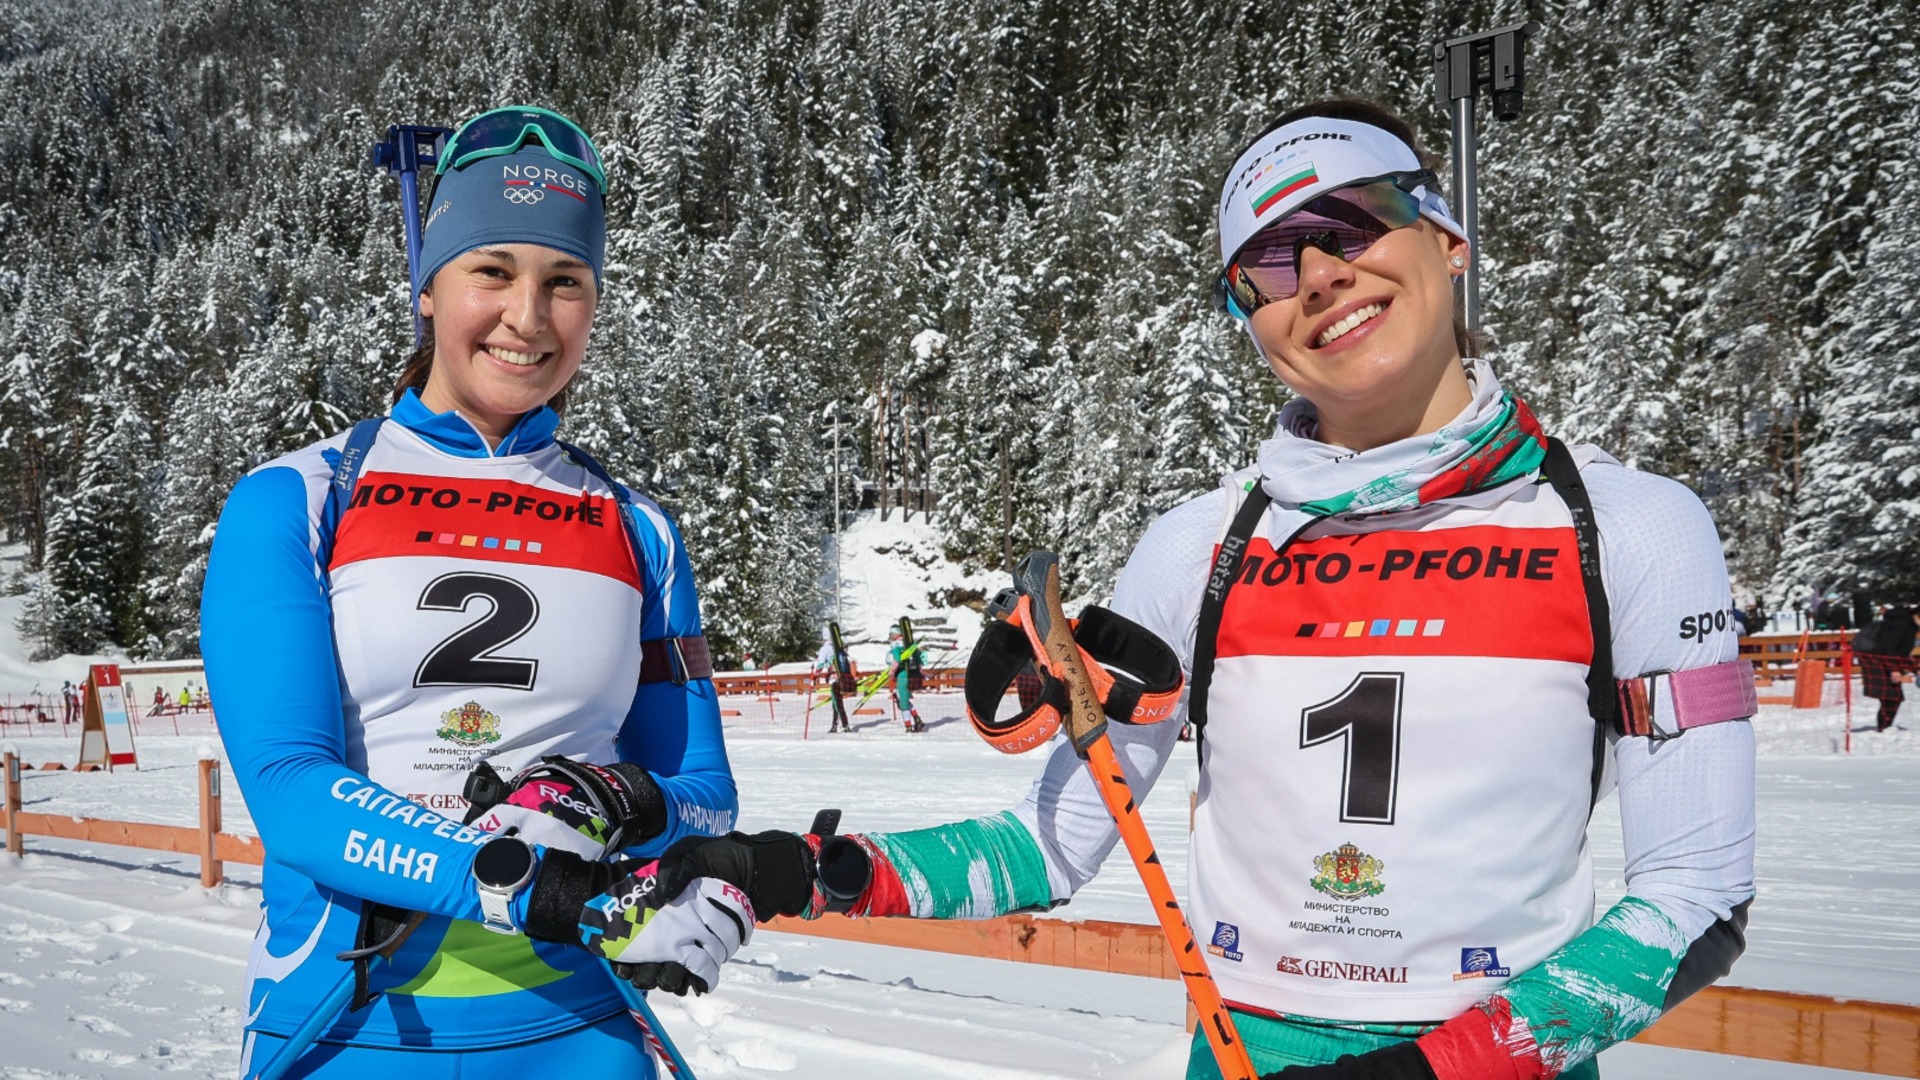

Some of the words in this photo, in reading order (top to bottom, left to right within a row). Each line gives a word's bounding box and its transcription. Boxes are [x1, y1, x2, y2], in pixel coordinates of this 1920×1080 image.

[503, 164, 587, 197] NORGE
[412, 570, 541, 692] 2
[103, 672, 111, 685] 1
[1299, 671, 1405, 826] 1
[343, 829, 439, 884] БАНЯ
[1304, 900, 1390, 917] МИНИСТЕРСТВО
[1335, 915, 1351, 924] НА
[1288, 920, 1345, 935] МЛАДЕЖТА
[1347, 926, 1356, 936] И
[1357, 927, 1403, 940] СПОРТА
[1304, 959, 1409, 984] GENERALI
